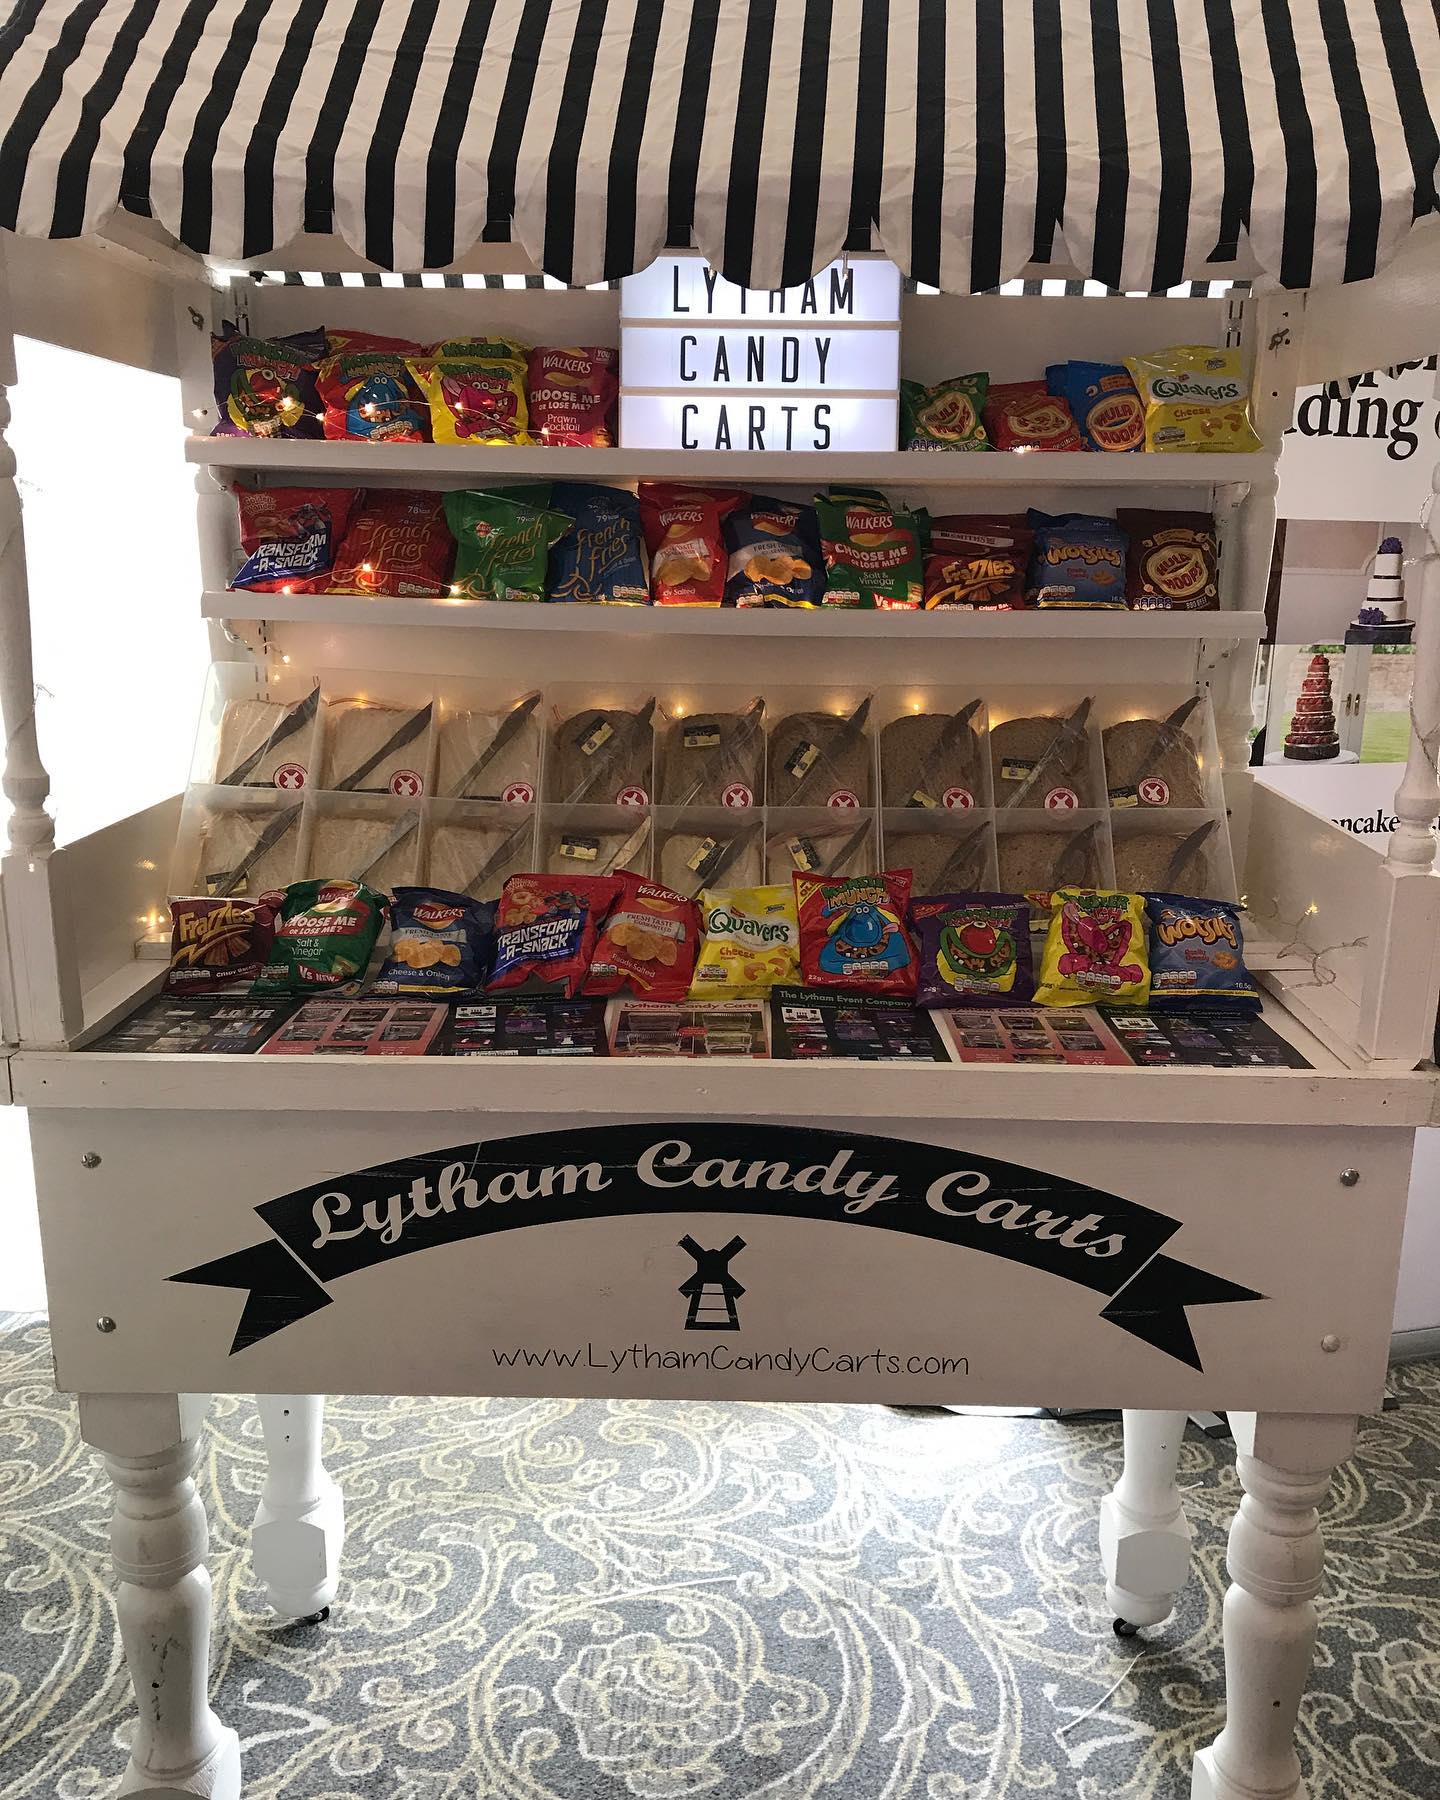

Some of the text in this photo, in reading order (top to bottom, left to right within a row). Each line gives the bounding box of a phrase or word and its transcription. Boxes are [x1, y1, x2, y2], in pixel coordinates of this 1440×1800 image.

[542, 354, 592, 374] WALKERS
[680, 336, 831, 384] CANDY
[530, 389, 600, 404] CHOOSE ME
[1152, 378, 1239, 400] Quavers
[548, 402, 570, 410] LOSE
[571, 403, 591, 411] ME?
[1099, 404, 1133, 426] HULA
[1174, 407, 1211, 419] Cheese
[542, 421, 580, 432] Cocktail
[547, 413, 577, 423] Prawn
[1284, 382, 1424, 461] ding
[681, 405, 830, 450] CARTS
[1100, 414, 1144, 443] HOOPS
[660, 511, 705, 527] WALKERS
[846, 514, 894, 529] WALKERS
[257, 533, 327, 559] RANSFORM
[834, 543, 908, 561] CHOOSE ME
[861, 561, 880, 569] LOSE
[882, 559, 900, 568] ME?
[1156, 552, 1193, 576] HULA
[859, 577, 896, 587] Vinegar
[1164, 560, 1204, 590] HOOPS
[1338, 809, 1401, 834] ncake
[636, 885, 688, 902] WALKERS
[829, 887, 890, 910] MUNCH
[285, 914, 357, 928] CHOOSE ME
[413, 906, 465, 919] WALKERS
[627, 914, 673, 927] FRESH TASTE
[179, 901, 256, 943] Frazzles
[321, 926, 343, 934] ME?
[708, 908, 790, 943] Quavers
[498, 918, 579, 951] TRANSFORM
[1157, 916, 1238, 949] Wotsits
[297, 938, 312, 947] Salt
[720, 947, 755, 960] Cheese
[216, 969, 236, 978] Crispy
[300, 966, 312, 980] Vs
[612, 953, 656, 978] Ready Salted
[388, 968, 417, 976] Cheese
[426, 969, 450, 981] Onion
[779, 990, 797, 999] The
[800, 992, 834, 1002] Lytham
[837, 994, 863, 1004] Event
[866, 997, 913, 1007] Company
[312, 1140, 1126, 1257] Lytham Candy Carts
[493, 1343, 969, 1376] www.LythamCandyCarts.com
